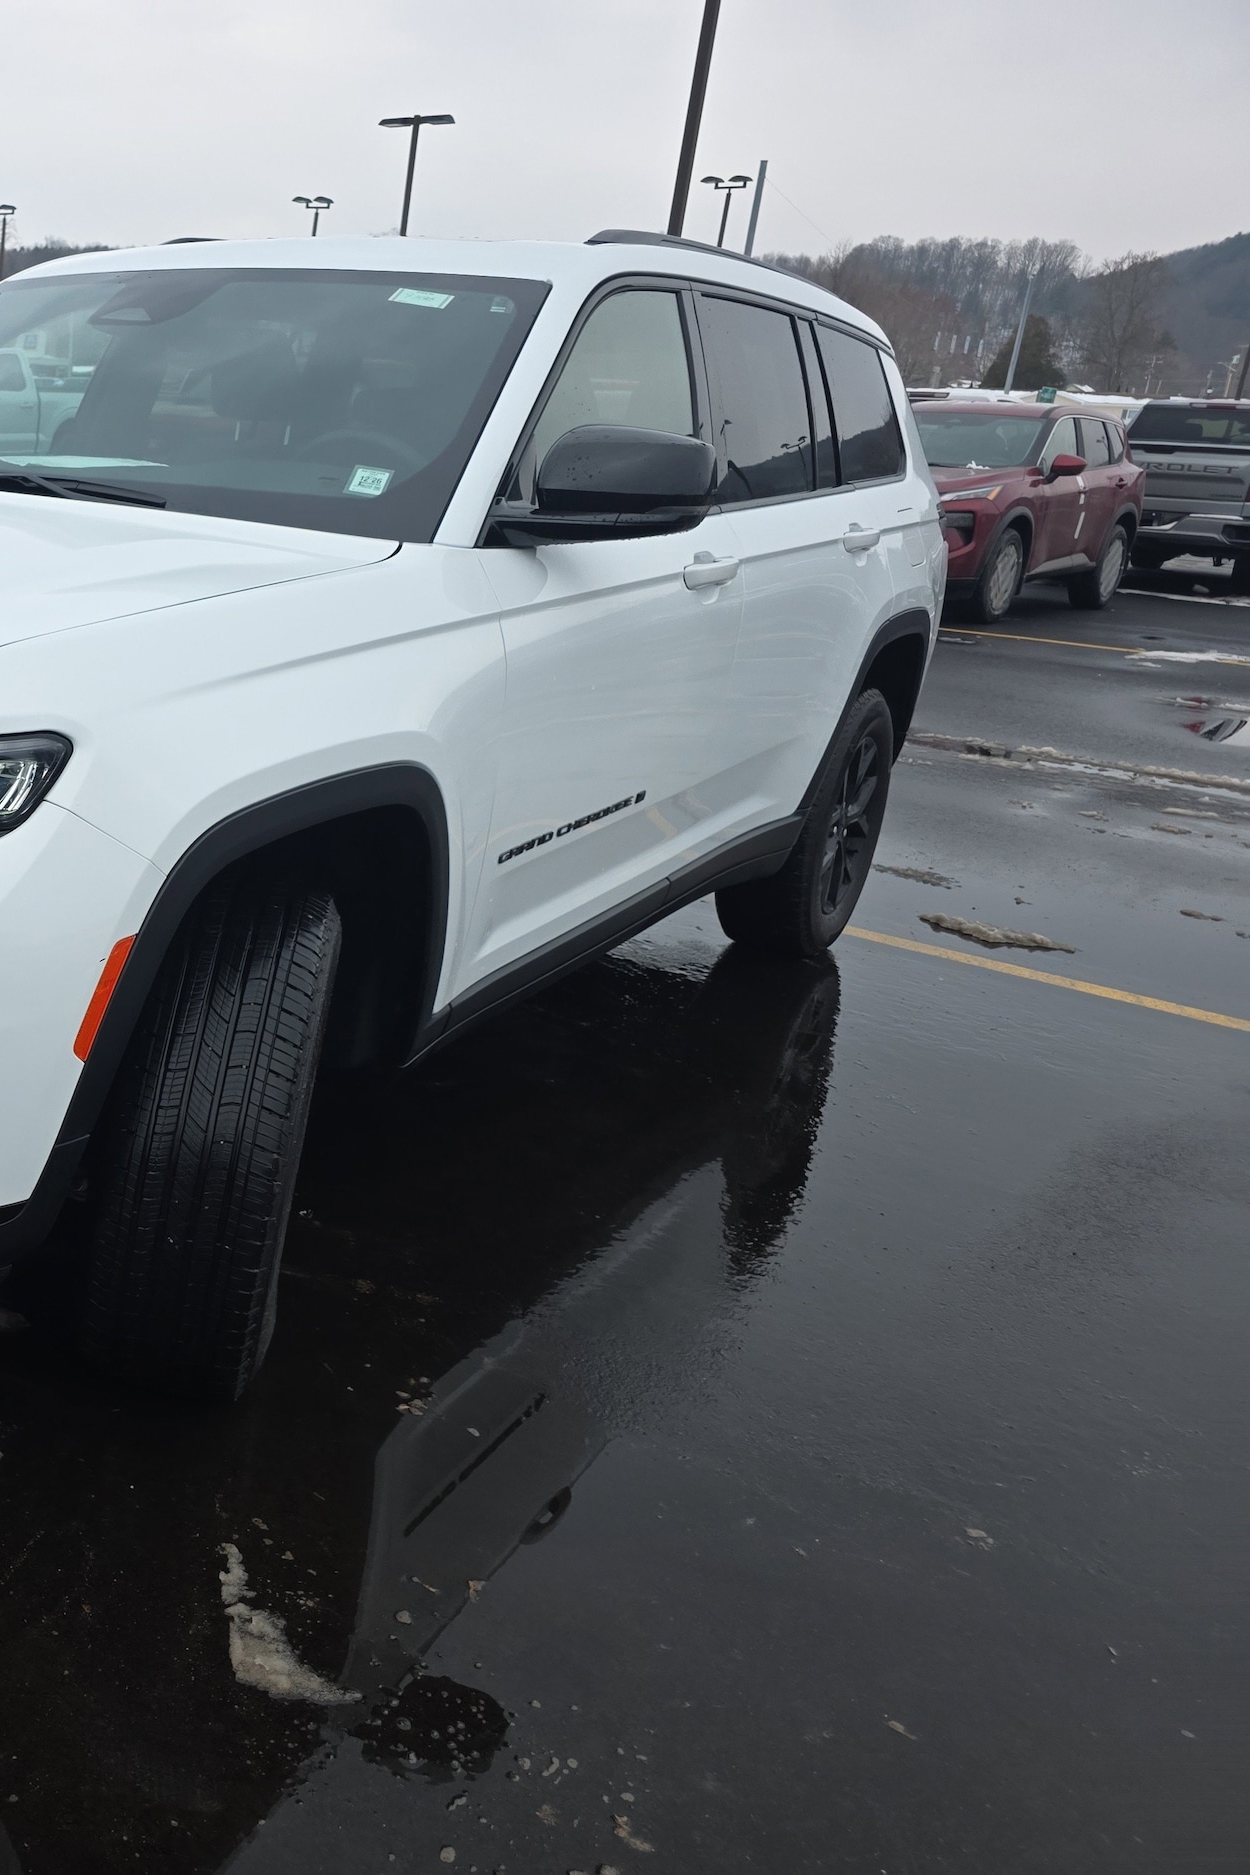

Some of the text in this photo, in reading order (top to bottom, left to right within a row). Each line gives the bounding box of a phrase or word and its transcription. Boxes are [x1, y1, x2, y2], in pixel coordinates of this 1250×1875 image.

[1144, 462, 1239, 474] ROLET
[497, 796, 635, 865] GRAND CHEROKEE
